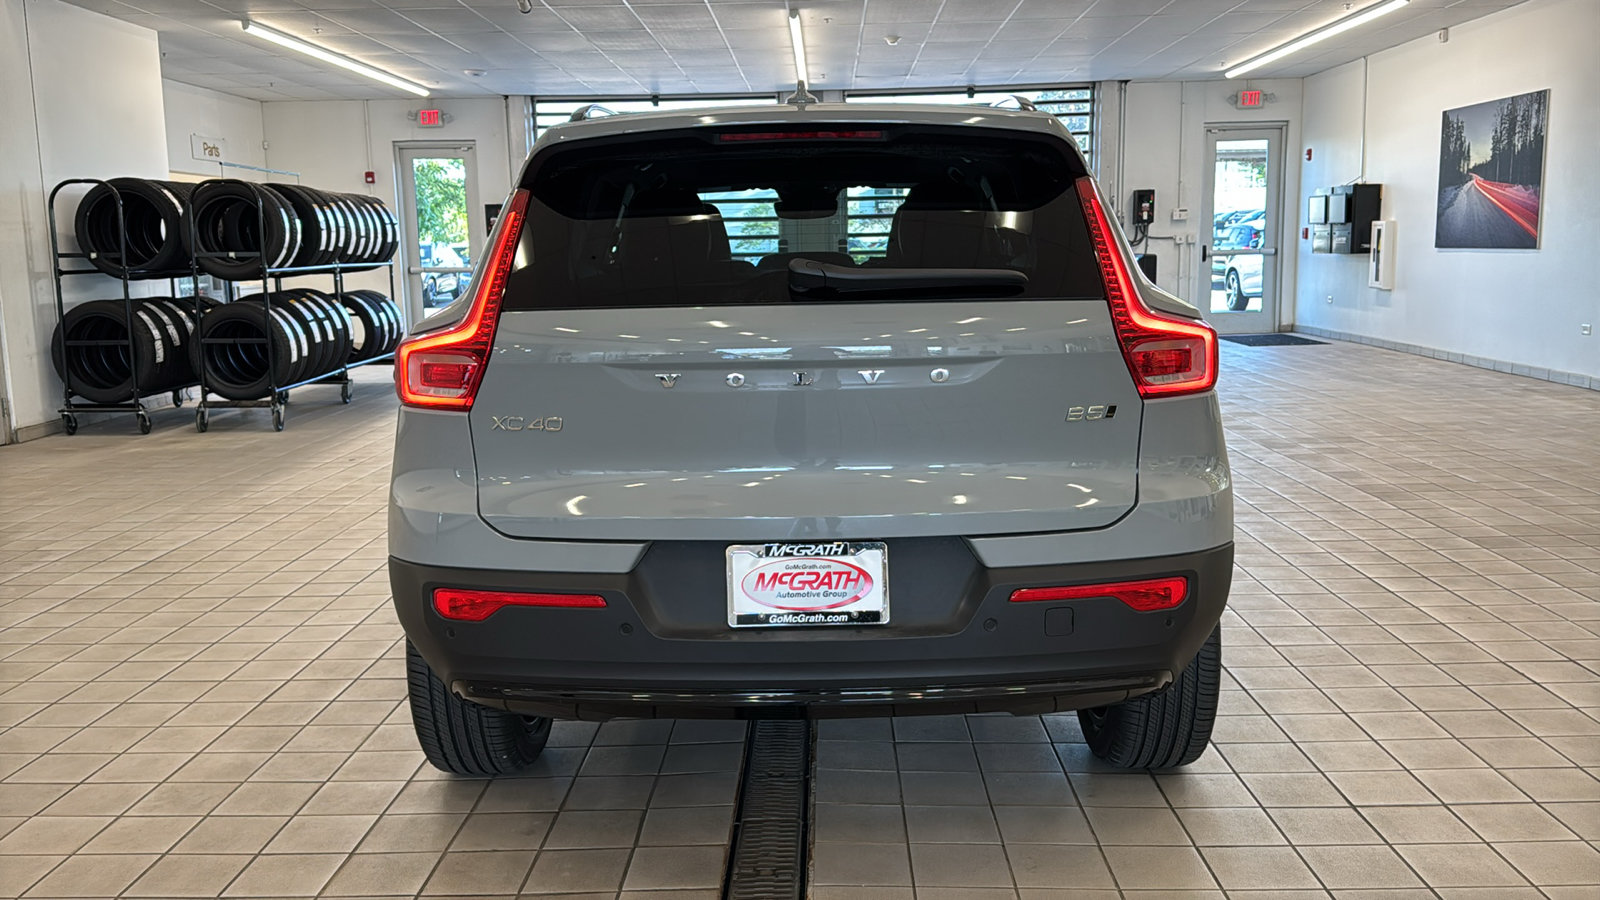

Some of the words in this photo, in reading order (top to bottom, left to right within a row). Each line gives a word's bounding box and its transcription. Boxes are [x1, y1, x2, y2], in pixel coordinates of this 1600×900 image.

[1242, 90, 1260, 106] EXIT
[421, 110, 439, 125] EXIT
[203, 142, 220, 157] Parts
[655, 368, 950, 388] VOLVO
[776, 591, 821, 599] Automotive
[822, 590, 848, 599] Group
[769, 613, 849, 624] GoMcGrath.com
